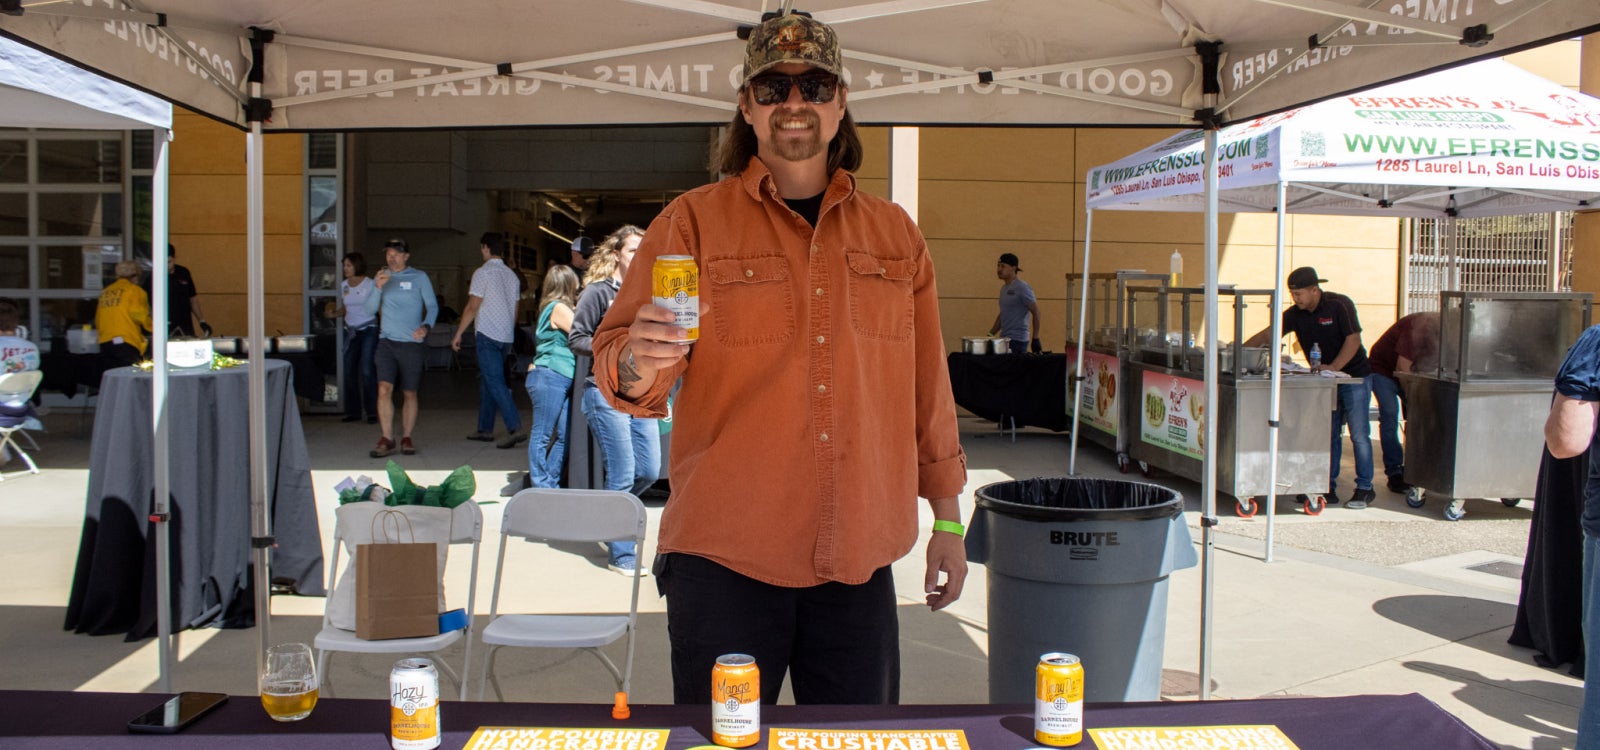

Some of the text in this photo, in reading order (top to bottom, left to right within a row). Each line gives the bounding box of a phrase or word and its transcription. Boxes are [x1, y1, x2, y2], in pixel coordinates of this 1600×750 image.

[1376, 158, 1410, 171] 1285
[1415, 159, 1462, 173] Laurel
[1468, 161, 1490, 176] Ln,
[1496, 161, 1524, 176] San
[1529, 162, 1561, 177] Luis
[1151, 177, 1162, 188] San
[1163, 174, 1176, 187] Luis
[1218, 163, 1233, 178] 3401
[1050, 530, 1119, 546] BRUTE
[392, 682, 427, 707] Hazy
[717, 679, 752, 703] Mango
[482, 728, 660, 741] NOW POURING
[1097, 727, 1277, 740] NOW POURING
[473, 738, 658, 750] HANDCRAFTED
[777, 736, 963, 750] CRUSHABLE
[1102, 737, 1286, 750] HANDCRAFTED
